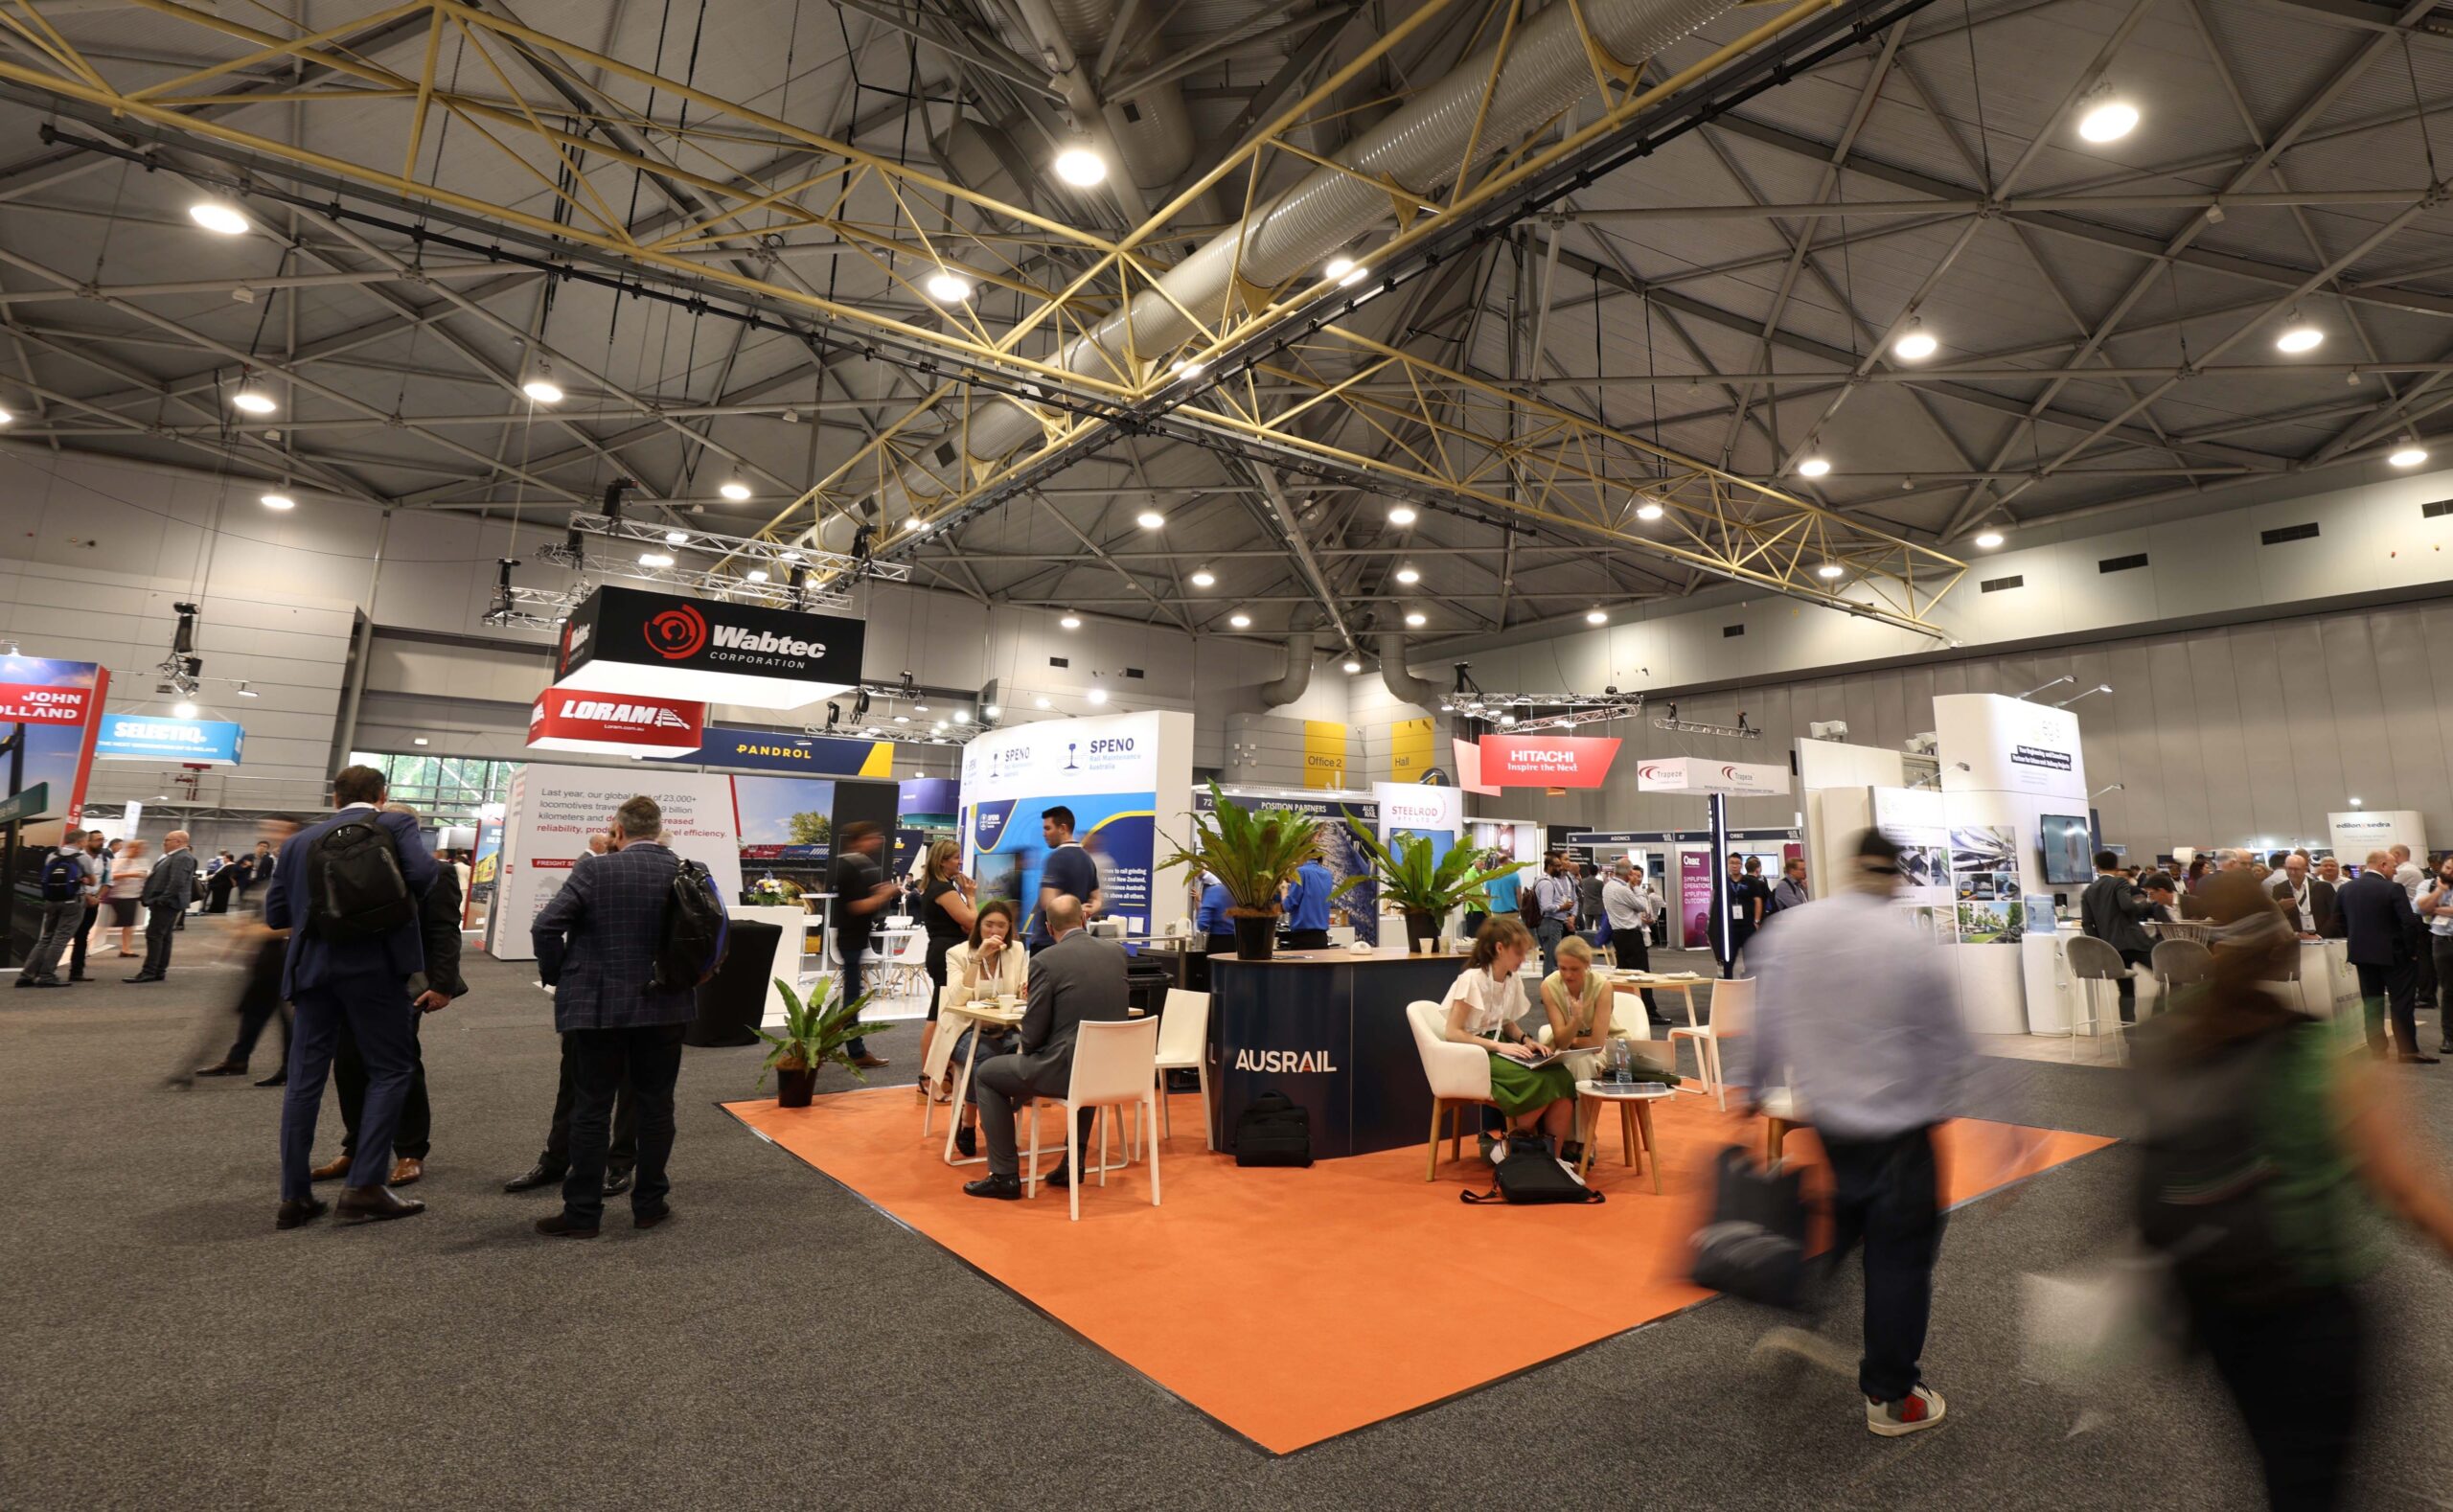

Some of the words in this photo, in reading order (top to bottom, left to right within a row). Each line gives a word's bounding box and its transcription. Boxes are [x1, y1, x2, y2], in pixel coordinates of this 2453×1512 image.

[712, 625, 827, 658] Wabtec
[710, 652, 805, 669] CORPORATION
[21, 691, 82, 705] JOHN
[560, 699, 657, 724] LORAM
[736, 744, 812, 759] PANDROL
[1089, 737, 1135, 754] SPENO
[1005, 746, 1030, 762] SPENO
[1511, 750, 1574, 763] HITACHI
[1308, 755, 1335, 767] Office
[1336, 758, 1342, 767] 2
[1394, 757, 1410, 767] Hall
[1507, 763, 1539, 772] Inspire
[1541, 764, 1555, 772] the
[1556, 764, 1578, 772] Next
[1657, 769, 1683, 779] Trapeze
[1734, 772, 1754, 781] Trapeze
[539, 800, 592, 810] locomotives
[1203, 798, 1212, 807] 72
[1261, 802, 1294, 812] POSITION
[1391, 806, 1438, 817] STEELROD
[539, 813, 584, 821] kilometers
[683, 830, 727, 838] efficiency.
[1235, 1048, 1338, 1073] AUSRAIL
